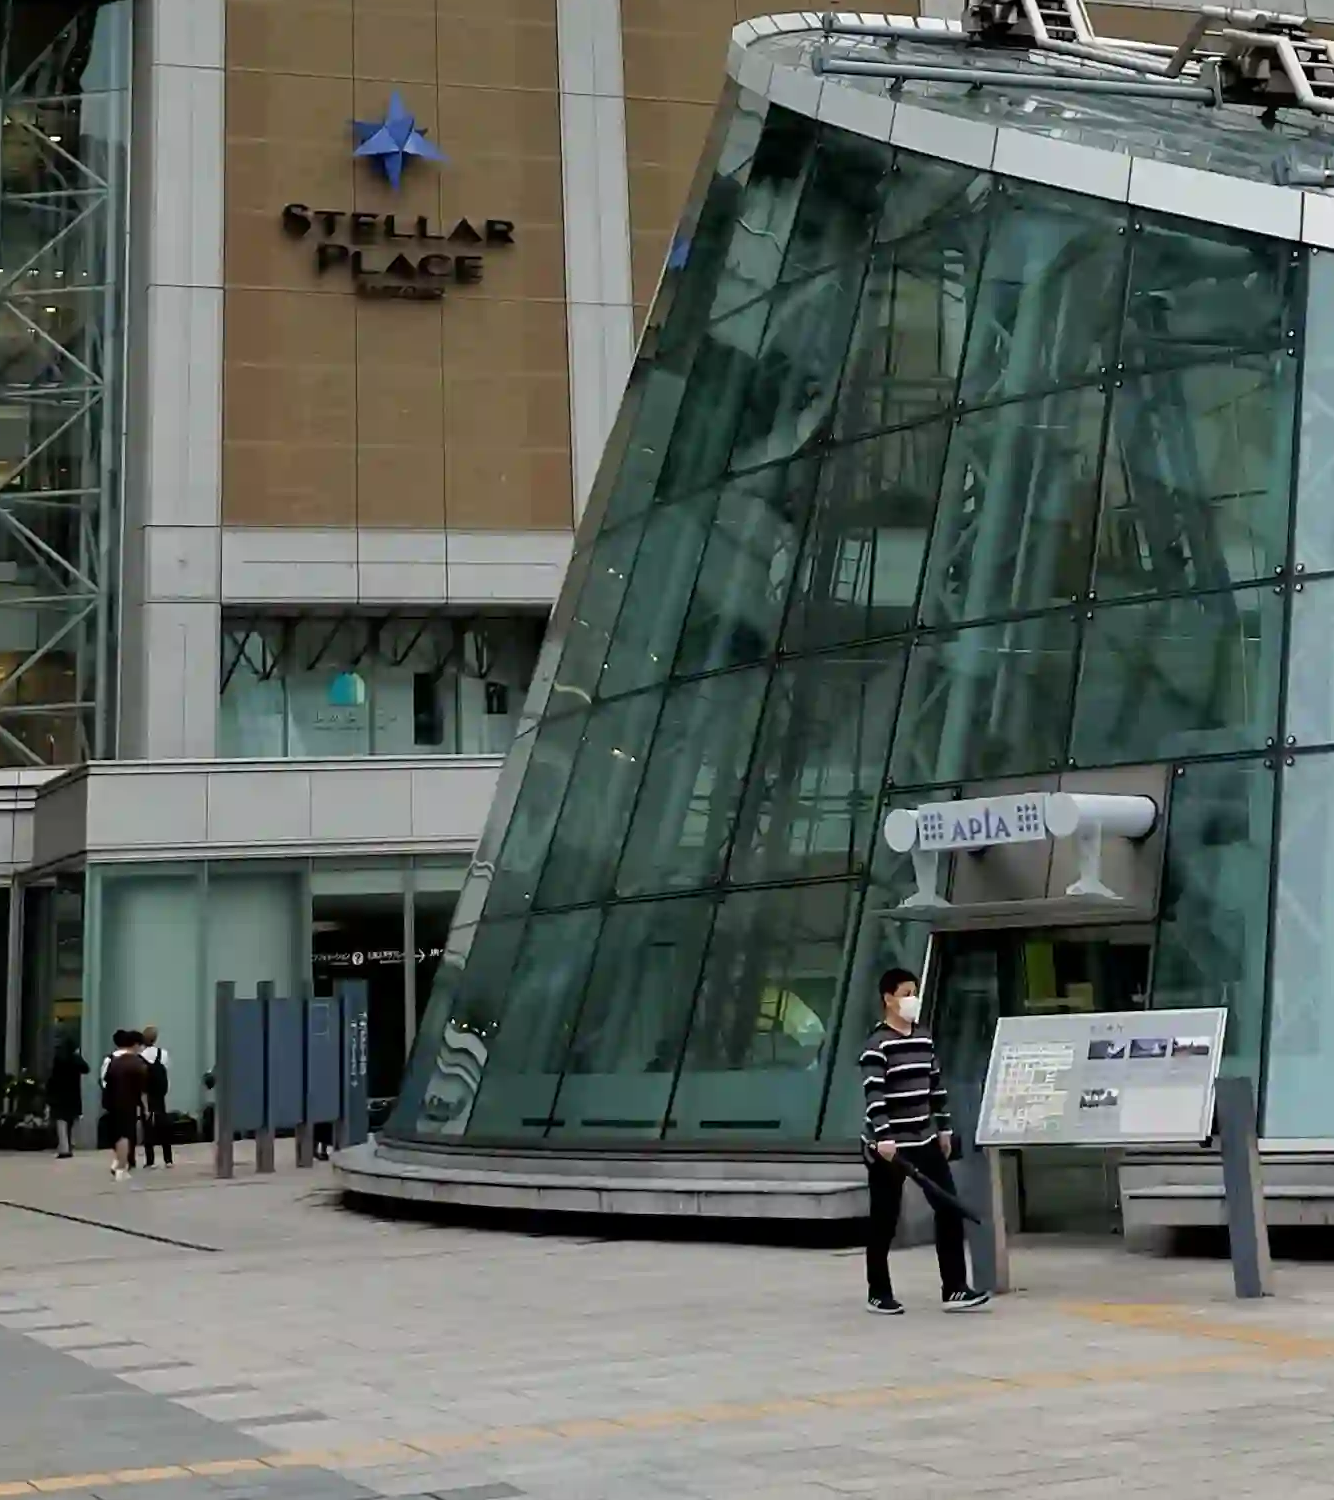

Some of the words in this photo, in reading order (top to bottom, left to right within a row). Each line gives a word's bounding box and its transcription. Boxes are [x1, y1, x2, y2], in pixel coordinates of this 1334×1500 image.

[281, 203, 515, 245] STELLAR
[315, 243, 484, 285] PLACE
[950, 806, 1012, 842] APIA
